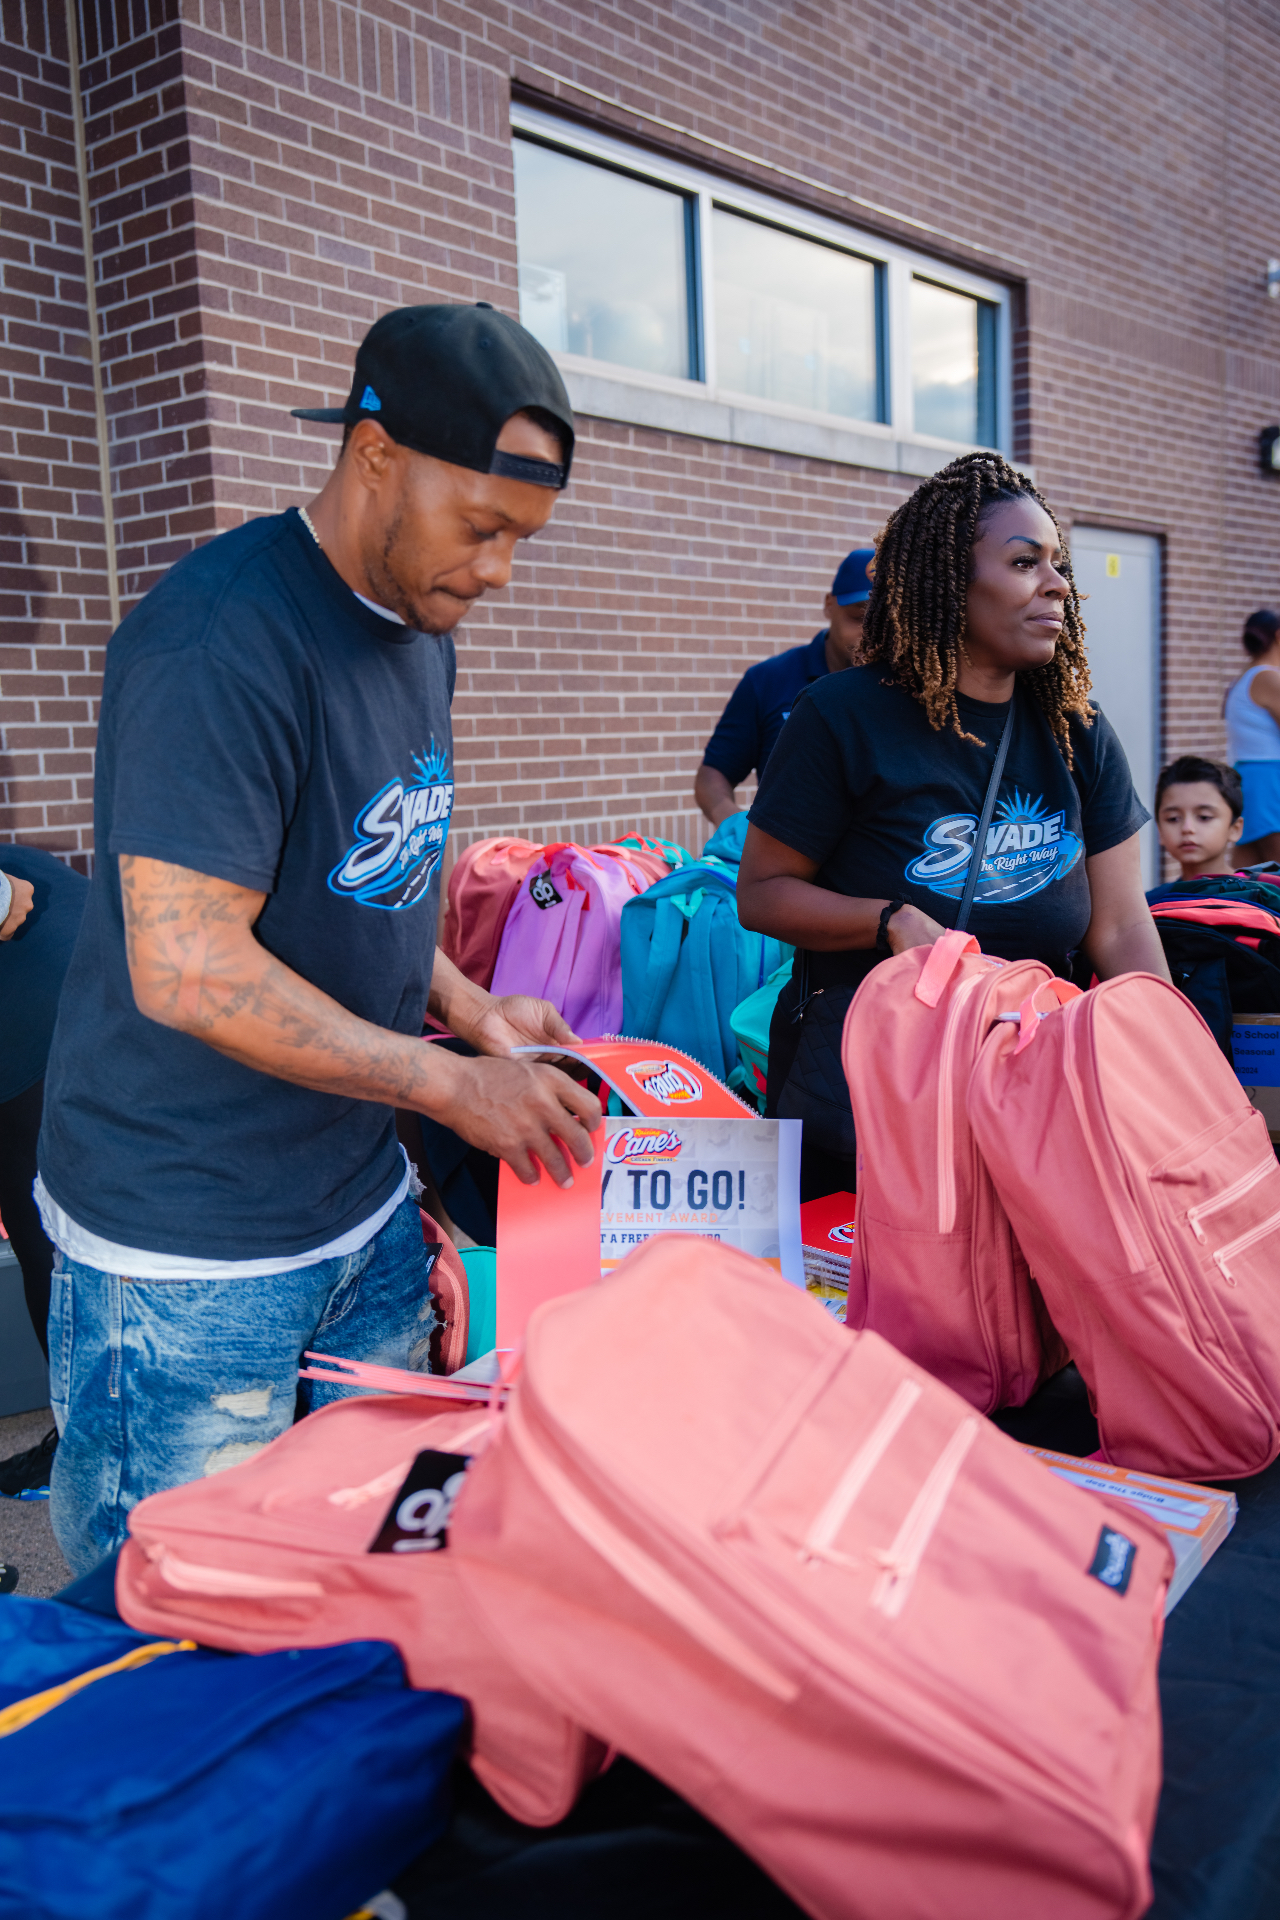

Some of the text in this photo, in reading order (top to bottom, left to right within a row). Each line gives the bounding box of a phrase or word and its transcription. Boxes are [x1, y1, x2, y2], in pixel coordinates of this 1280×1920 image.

[981, 846, 1059, 872] he Right Way
[1244, 1031, 1279, 1039] School
[1234, 1048, 1274, 1056] Seasonal
[606, 1127, 683, 1164] Cane's
[627, 1169, 671, 1210] TO
[687, 1169, 745, 1211] GO!
[670, 1212, 719, 1223] AWARD
[610, 1233, 618, 1244] A
[1108, 1485, 1126, 1494] The
[1130, 1490, 1165, 1503] Bridge
